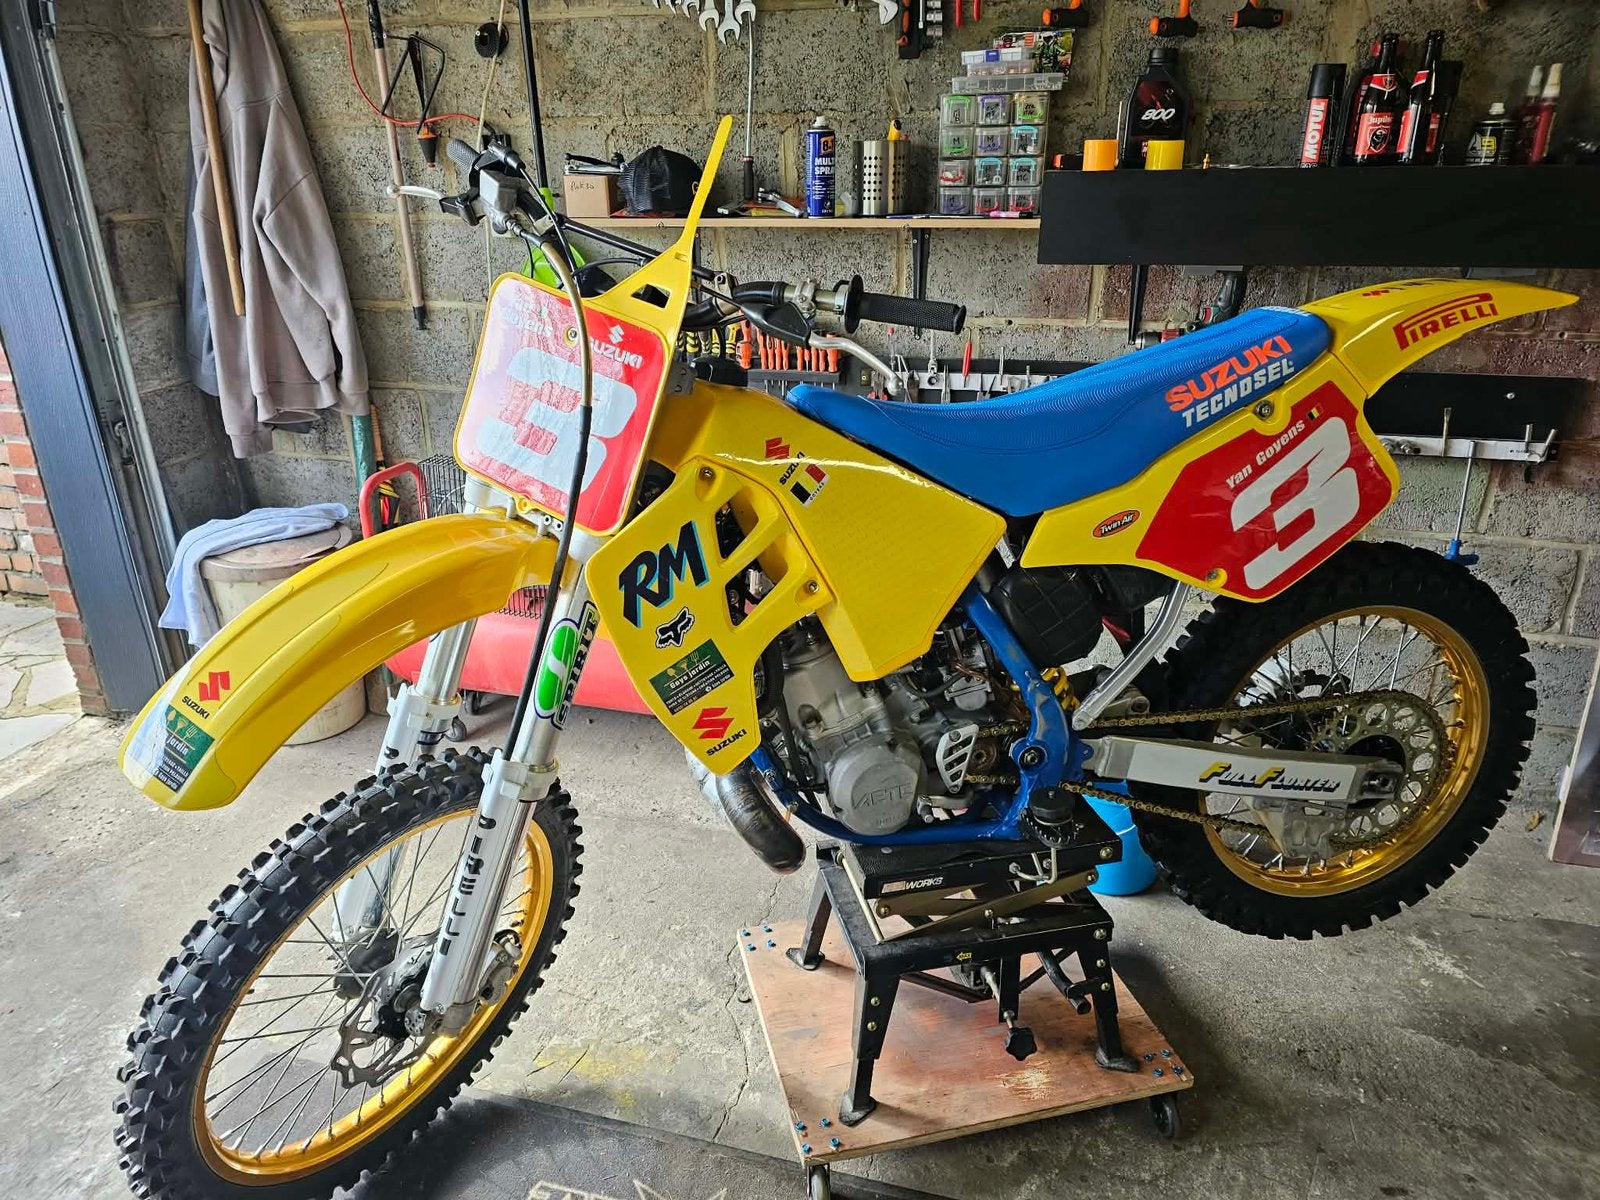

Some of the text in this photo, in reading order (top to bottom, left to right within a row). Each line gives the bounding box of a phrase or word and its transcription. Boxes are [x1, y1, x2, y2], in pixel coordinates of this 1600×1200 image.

[1142, 108, 1176, 120] 800
[1304, 102, 1326, 160] MOTUL
[1393, 292, 1498, 350] PIRELLI
[1165, 336, 1292, 412] SUZUKI
[1182, 358, 1294, 428] TECNOSEL
[476, 346, 638, 495] 3
[1255, 420, 1306, 466] Goyens
[1100, 513, 1135, 534] Twin Air
[1230, 416, 1360, 590] 3
[619, 520, 710, 628] RM
[558, 610, 596, 725] SPIRIT
[688, 659, 710, 678] jardin
[182, 696, 210, 720] SUZUKI
[166, 735, 189, 756] jardin
[706, 728, 748, 756] SUZUKI
[438, 814, 497, 956] PIRELLI
[906, 877, 944, 890] WORKS
